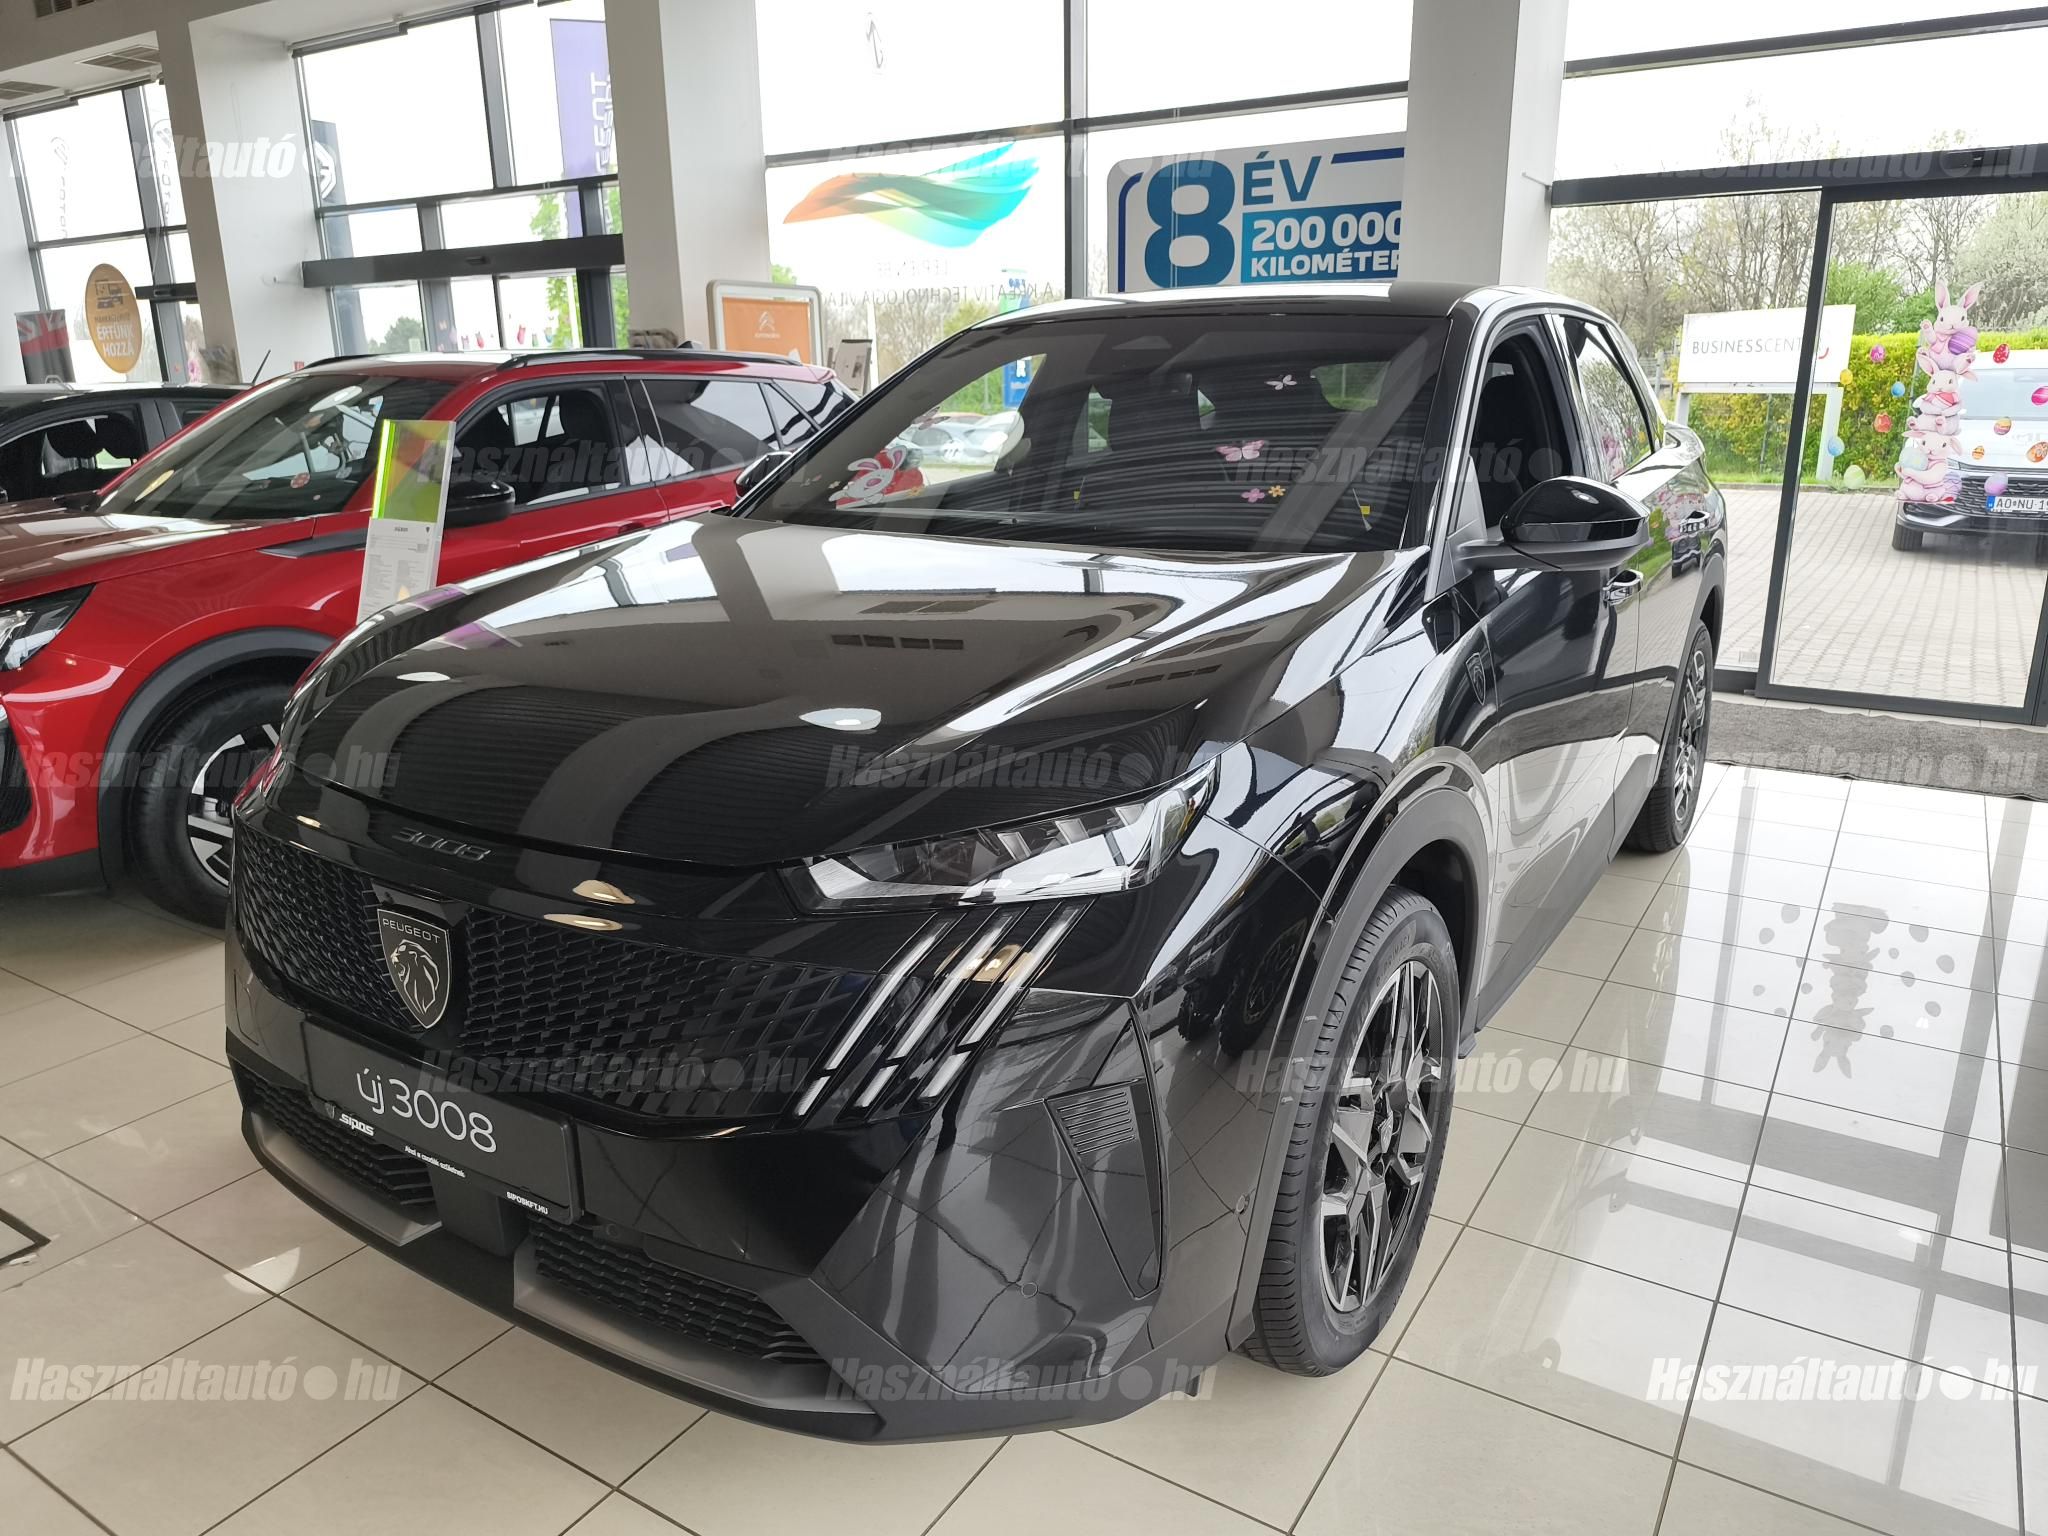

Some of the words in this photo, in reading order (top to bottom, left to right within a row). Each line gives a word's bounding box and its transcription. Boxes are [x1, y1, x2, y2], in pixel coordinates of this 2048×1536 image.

[1243, 151, 1322, 206] ÉV
[1144, 160, 1235, 288] 8
[1252, 215, 1326, 251] 200
[392, 827, 491, 860] 3008
[383, 918, 440, 943] PEUGEOT
[339, 1113, 374, 1136] sipos
[356, 1068, 385, 1115] új
[389, 1078, 497, 1153] 3008
